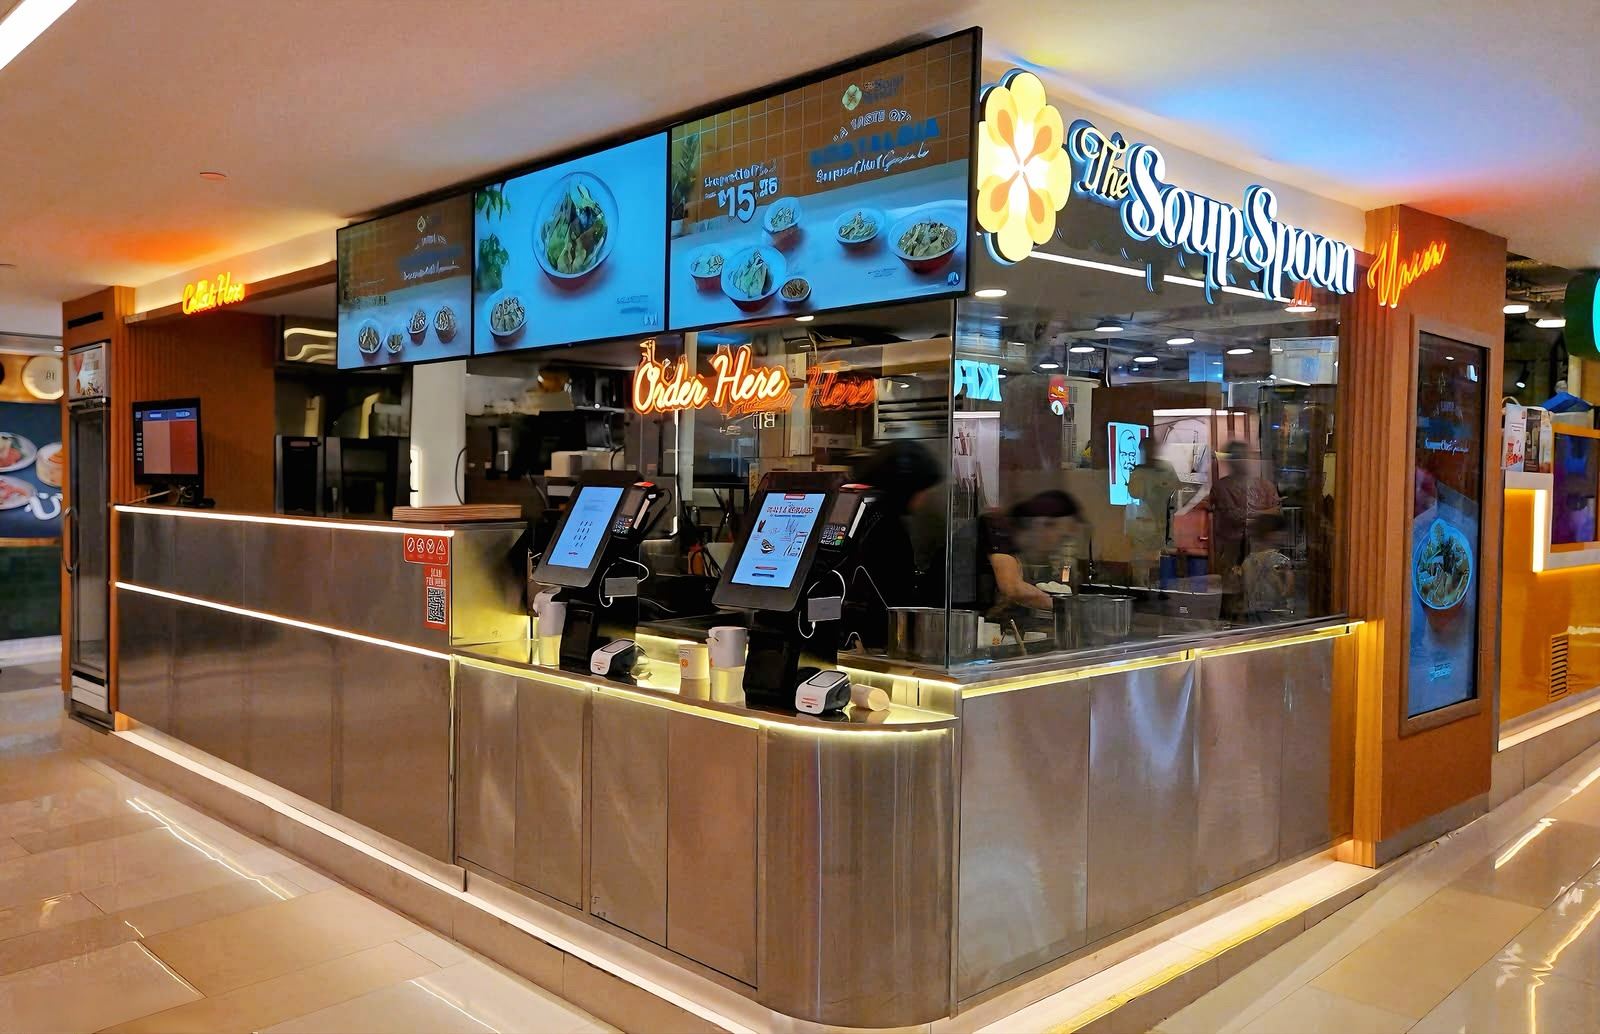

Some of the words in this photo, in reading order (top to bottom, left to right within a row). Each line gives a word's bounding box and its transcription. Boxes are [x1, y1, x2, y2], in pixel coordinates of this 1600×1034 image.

[1070, 124, 1130, 203] The
[1367, 231, 1447, 309] Union
[634, 358, 708, 413] Order
[712, 347, 788, 406] Here
